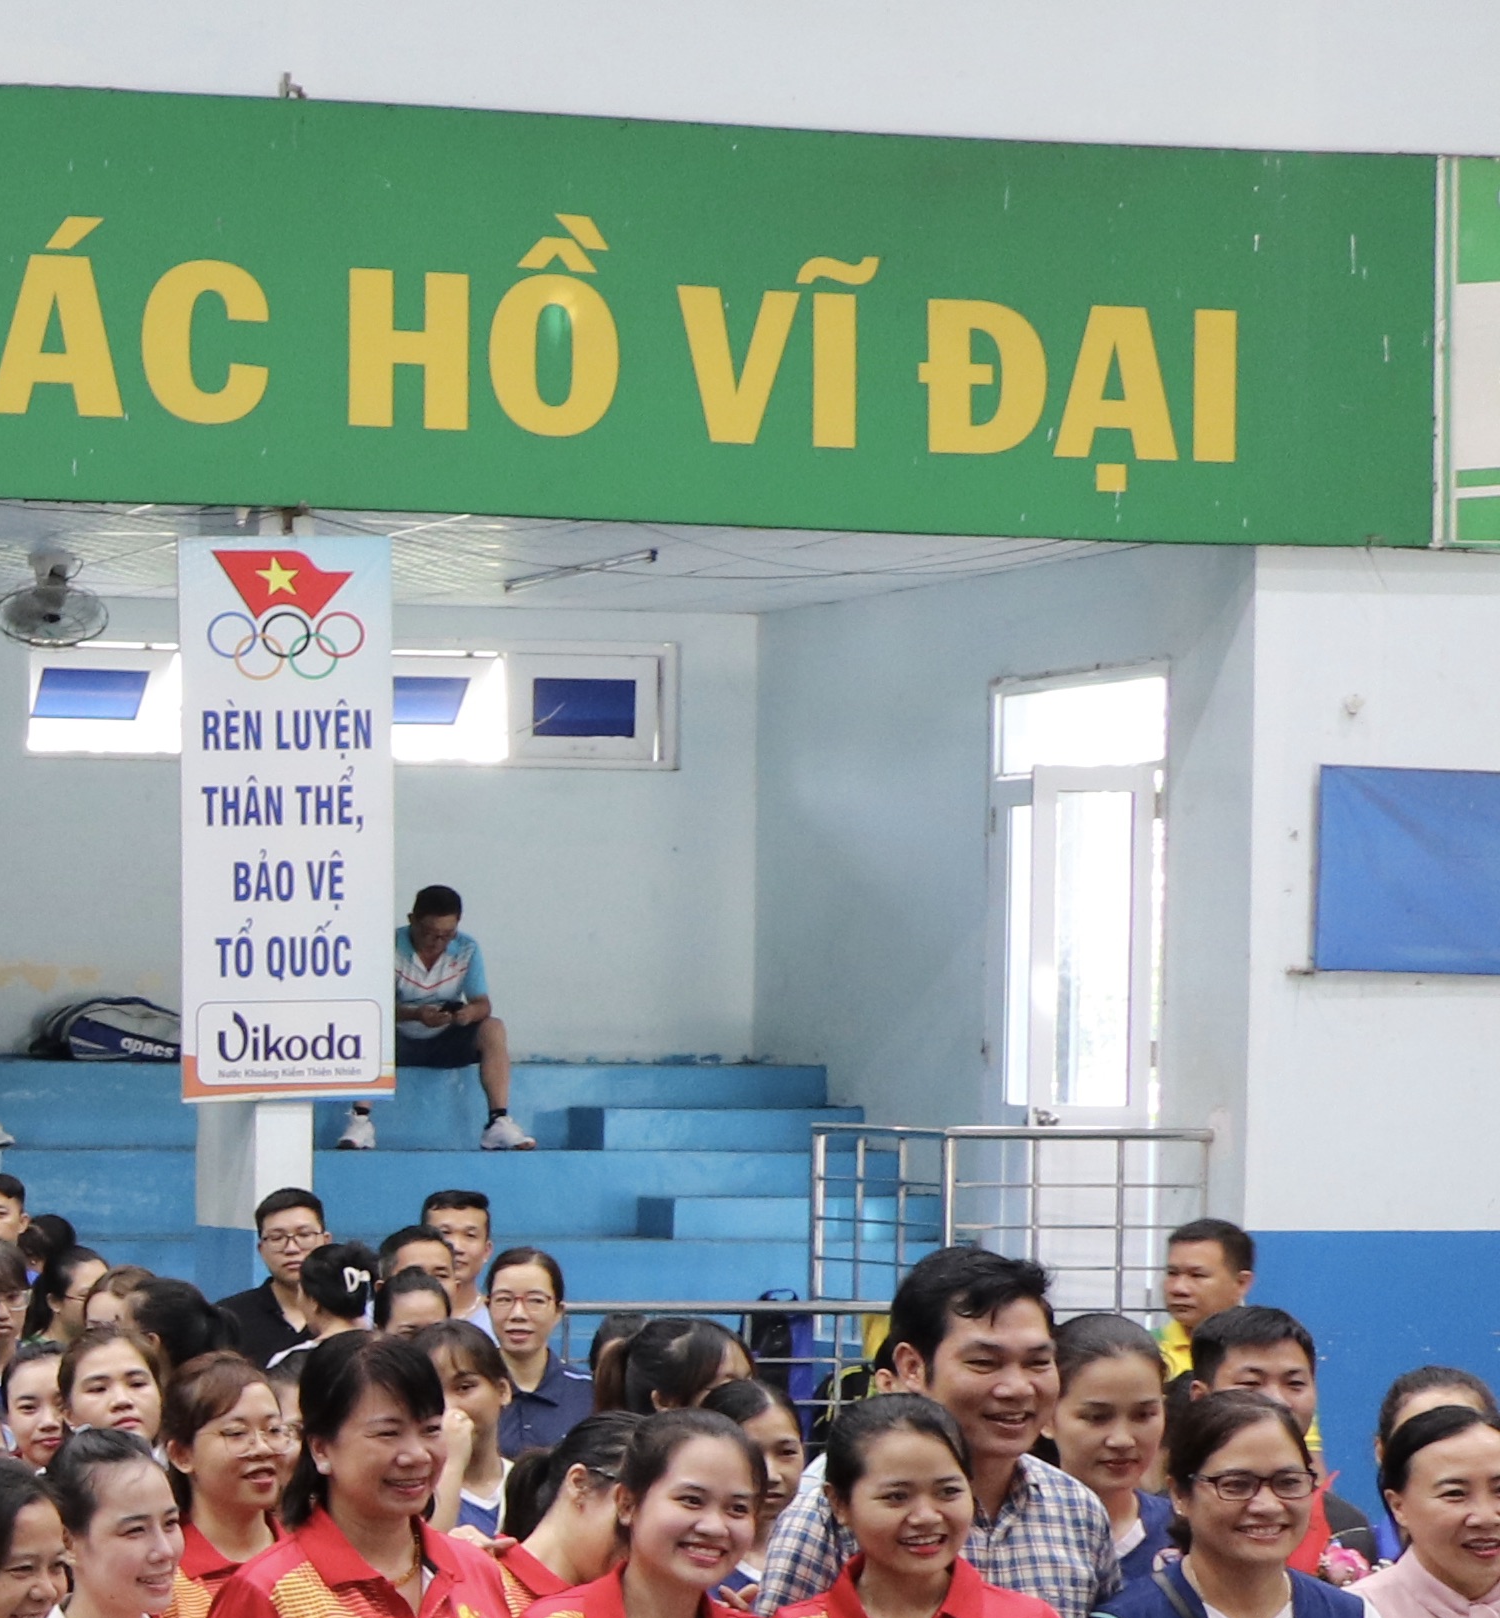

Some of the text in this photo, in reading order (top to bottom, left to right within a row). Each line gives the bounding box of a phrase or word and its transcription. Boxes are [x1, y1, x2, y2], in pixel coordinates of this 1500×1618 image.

[350, 215, 619, 435] HỒ
[679, 258, 878, 447] VĨ
[920, 300, 1236, 491] ĐẠI
[201, 699, 372, 759] RÈN LUYỆN
[201, 766, 363, 833] THÂN THỂ,
[233, 849, 345, 911] BẢO VỆ
[215, 919, 352, 981] TỔ QUỐC
[120, 1037, 175, 1058] apacs
